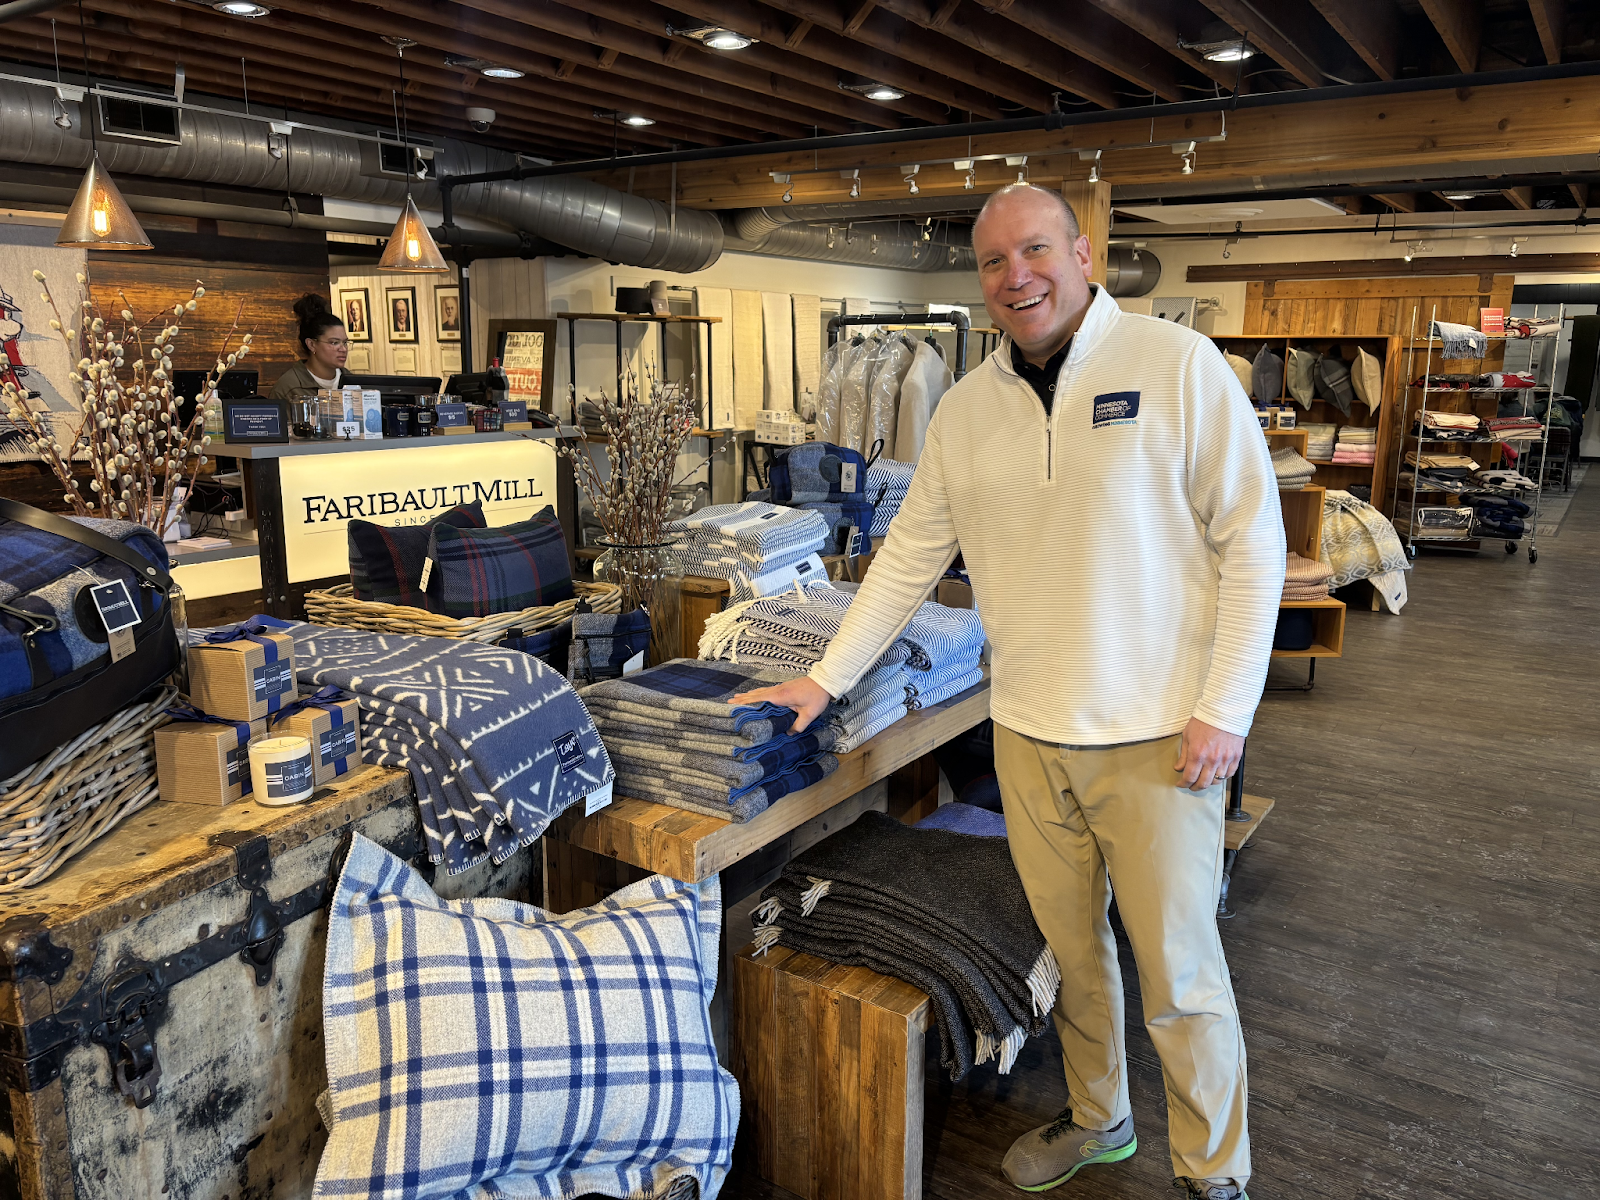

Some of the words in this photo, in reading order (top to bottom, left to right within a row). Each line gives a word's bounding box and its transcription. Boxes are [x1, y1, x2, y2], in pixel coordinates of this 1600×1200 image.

[1096, 400, 1128, 409] MINNESOTA
[1095, 406, 1122, 415] CHAMBER
[1095, 411, 1125, 420] COMMERCE
[284, 772, 304, 781] CABIN
